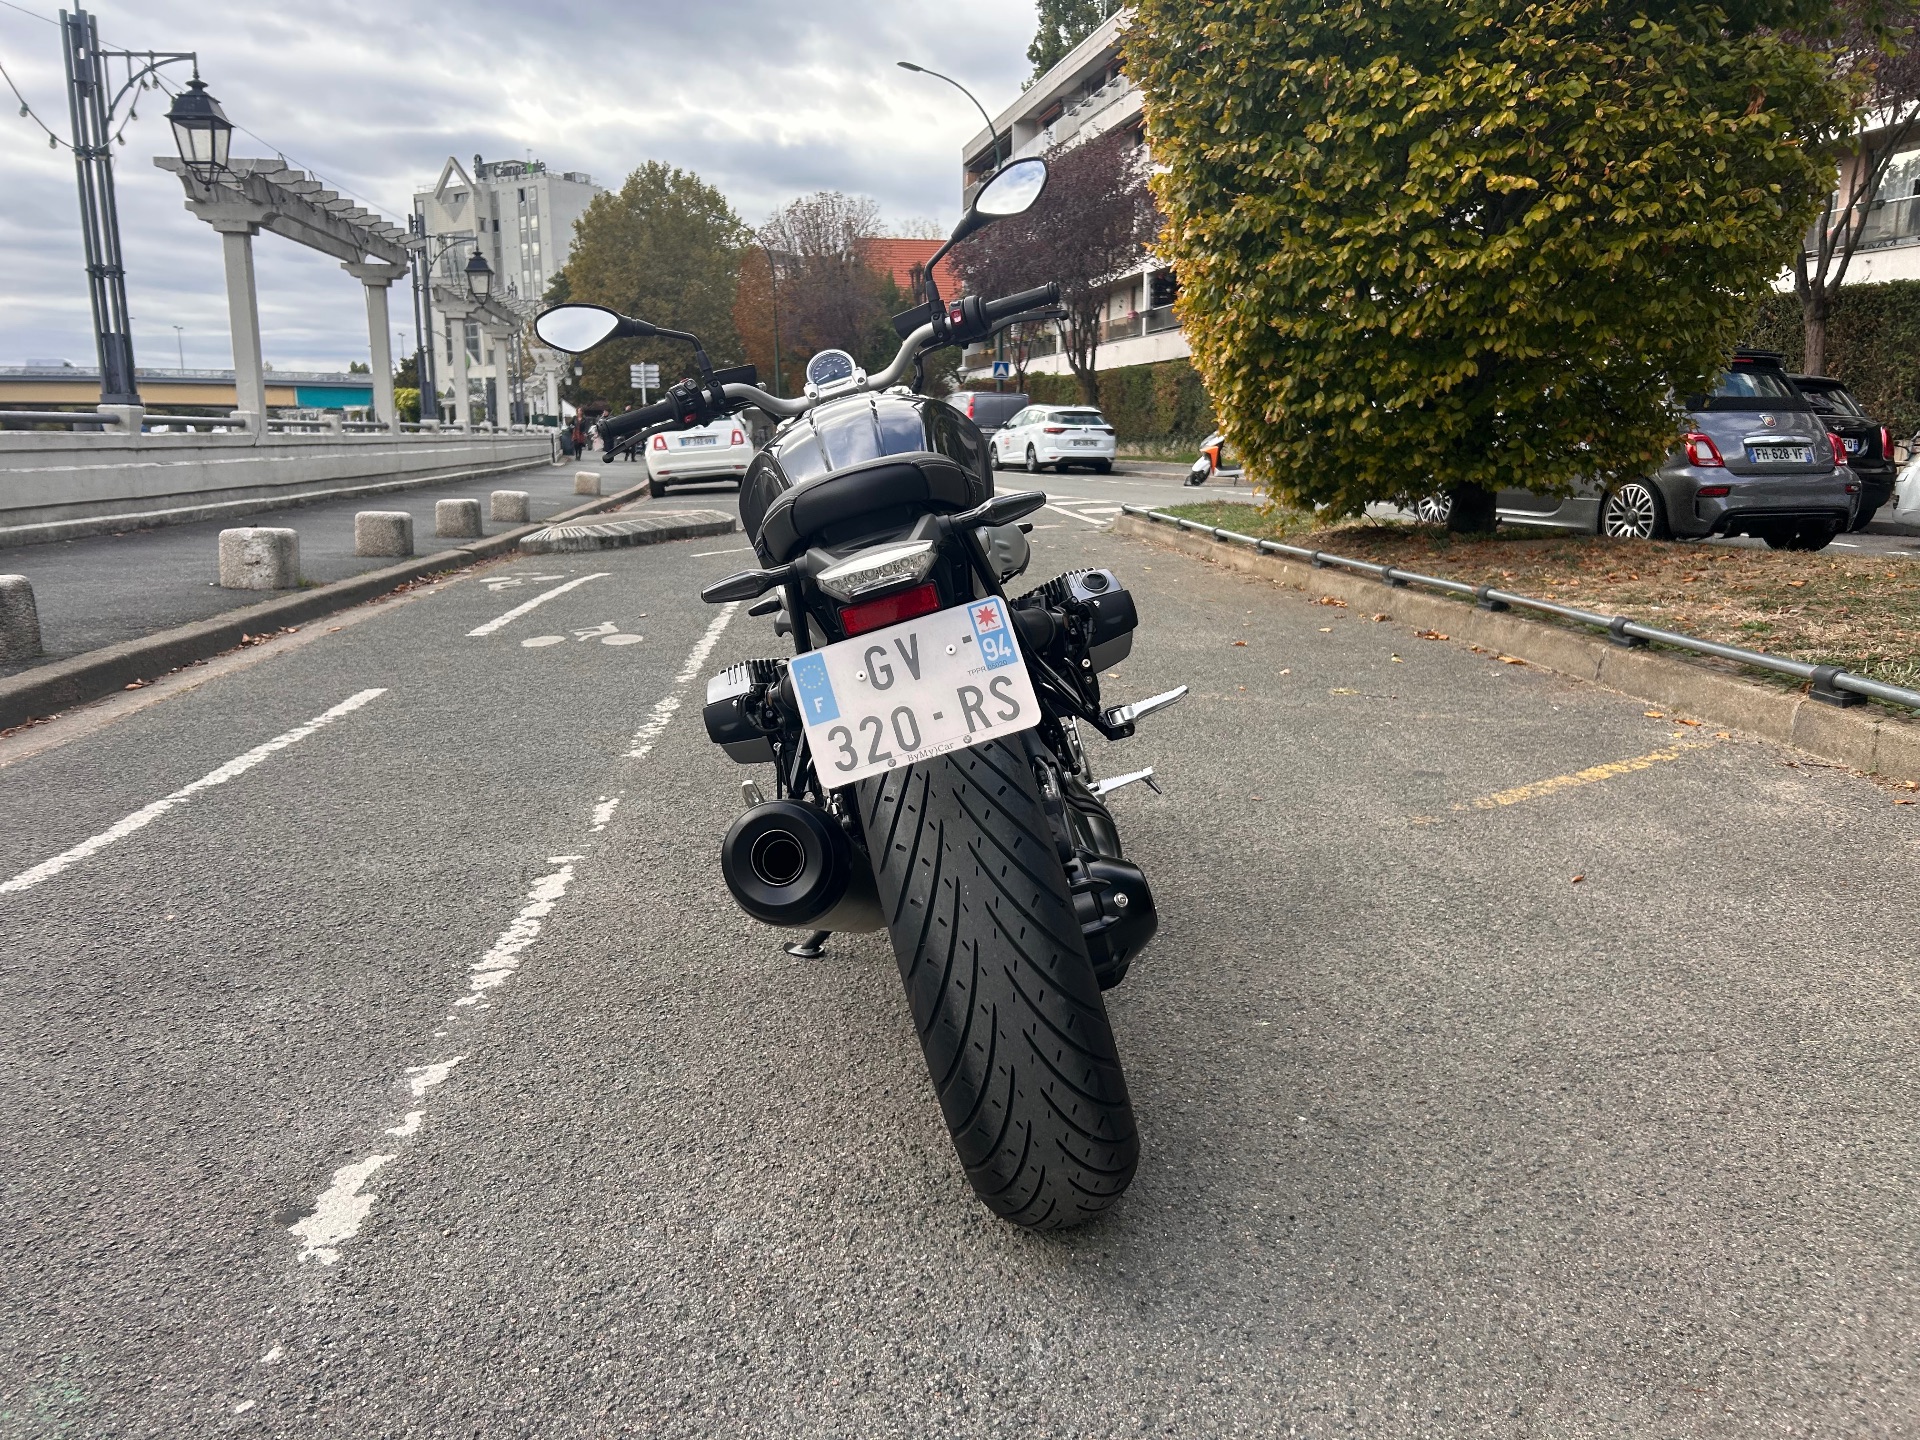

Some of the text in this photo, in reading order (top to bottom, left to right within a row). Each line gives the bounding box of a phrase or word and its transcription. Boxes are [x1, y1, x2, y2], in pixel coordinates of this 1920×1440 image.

[1755, 448, 1803, 460] FH-628-VF
[982, 633, 1012, 662] 94
[864, 633, 921, 690] GV
[814, 696, 824, 713] F
